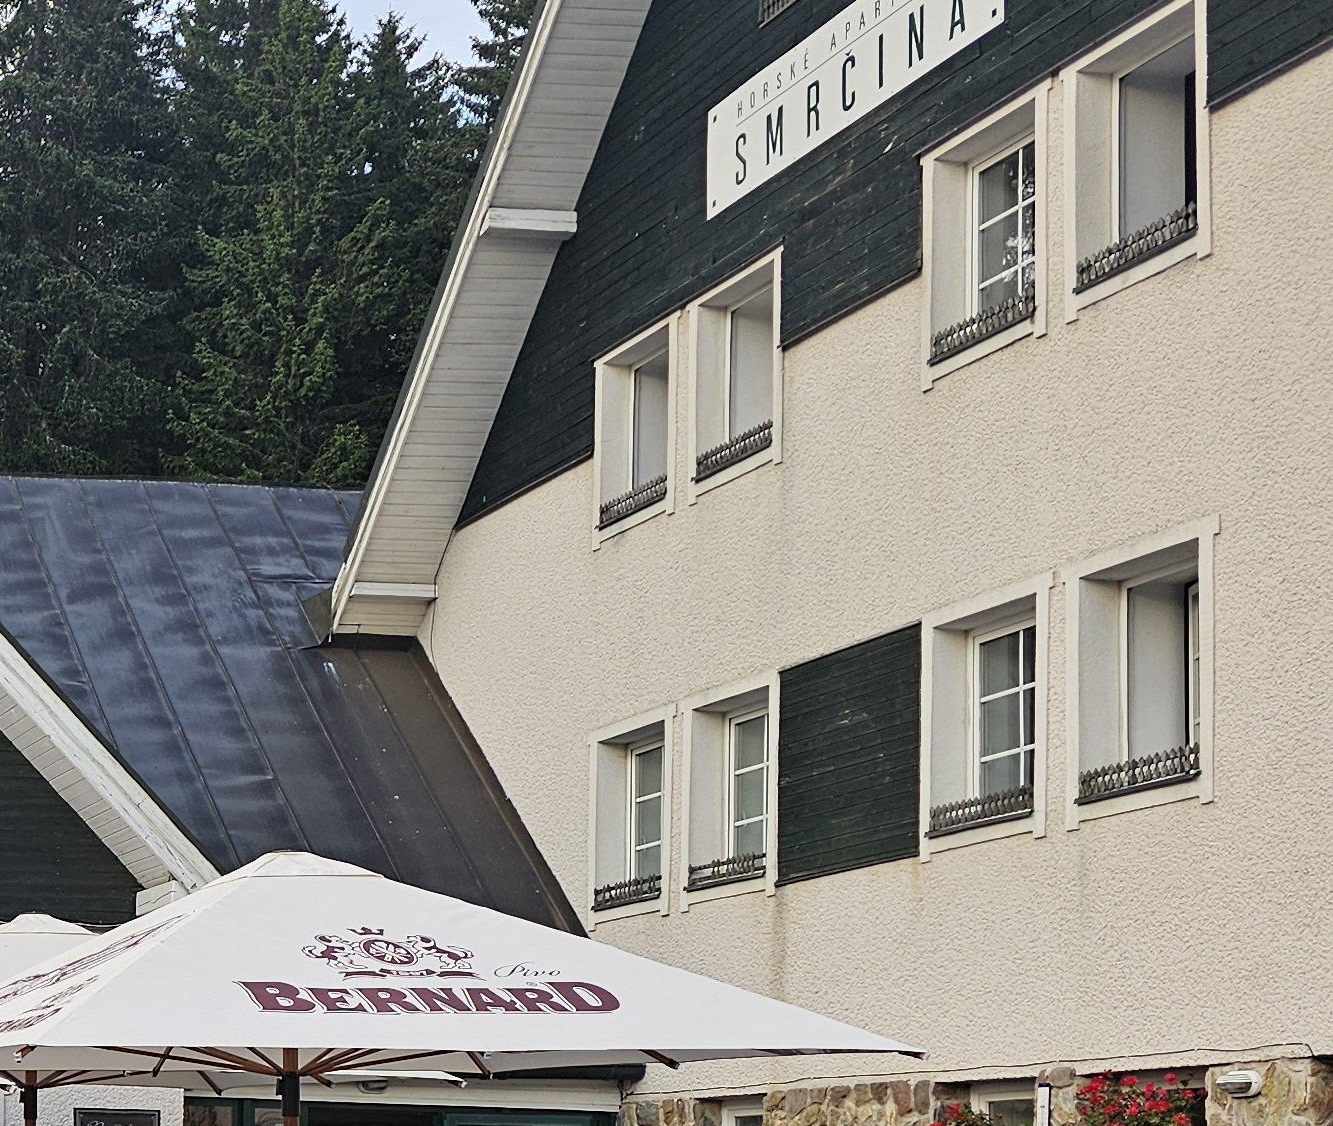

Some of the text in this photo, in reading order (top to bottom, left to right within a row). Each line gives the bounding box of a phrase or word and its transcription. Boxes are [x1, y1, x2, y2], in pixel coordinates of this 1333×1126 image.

[735, 0, 967, 186] SMRČINA
[737, 48, 810, 119] HORSKÉ
[493, 962, 562, 978] Pivo
[232, 980, 622, 1015] BERNARD
